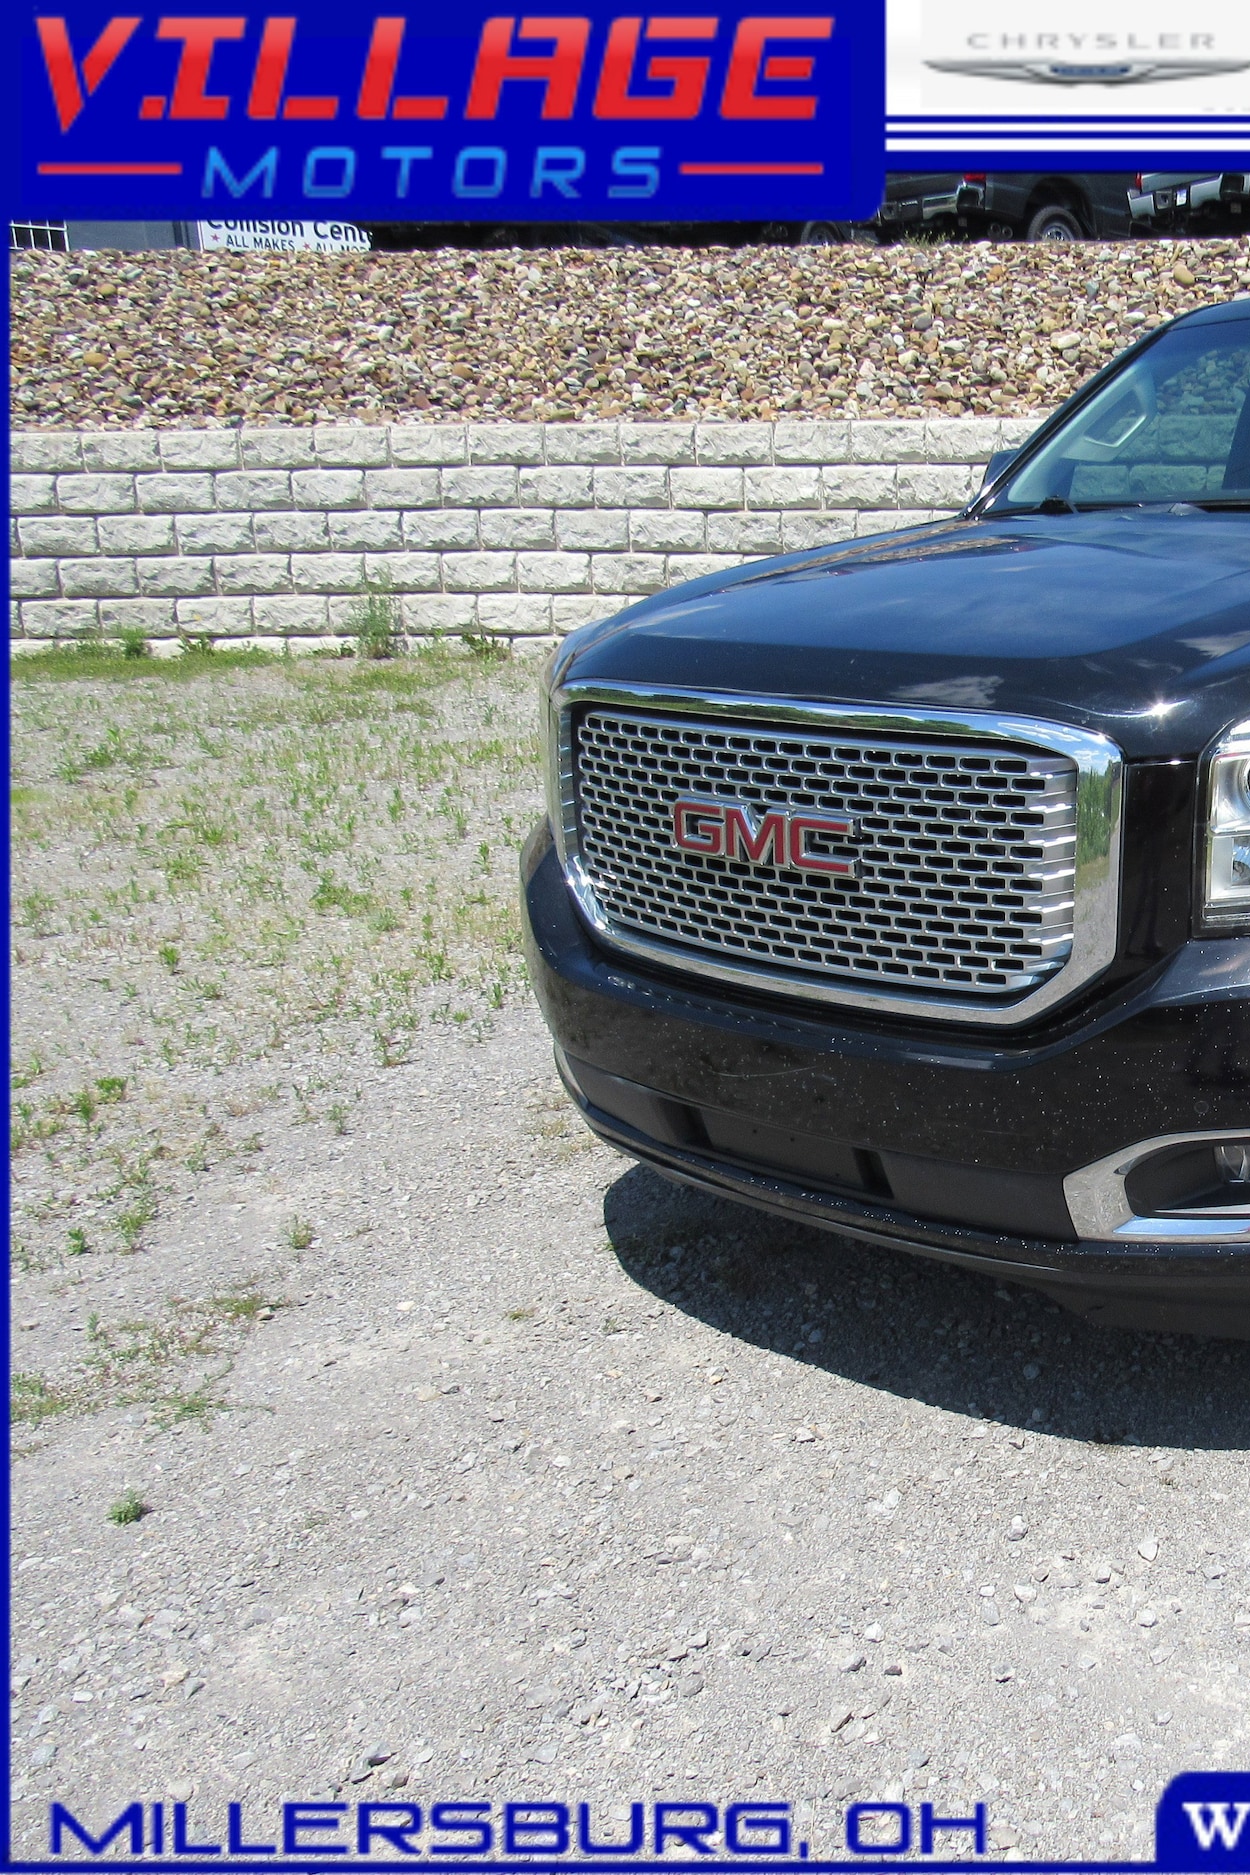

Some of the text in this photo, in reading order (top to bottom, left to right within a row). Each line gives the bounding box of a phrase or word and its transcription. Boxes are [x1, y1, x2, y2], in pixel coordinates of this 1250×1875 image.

[226, 234, 249, 249] ALL
[253, 236, 295, 252] MAKES
[674, 796, 861, 879] GMC
